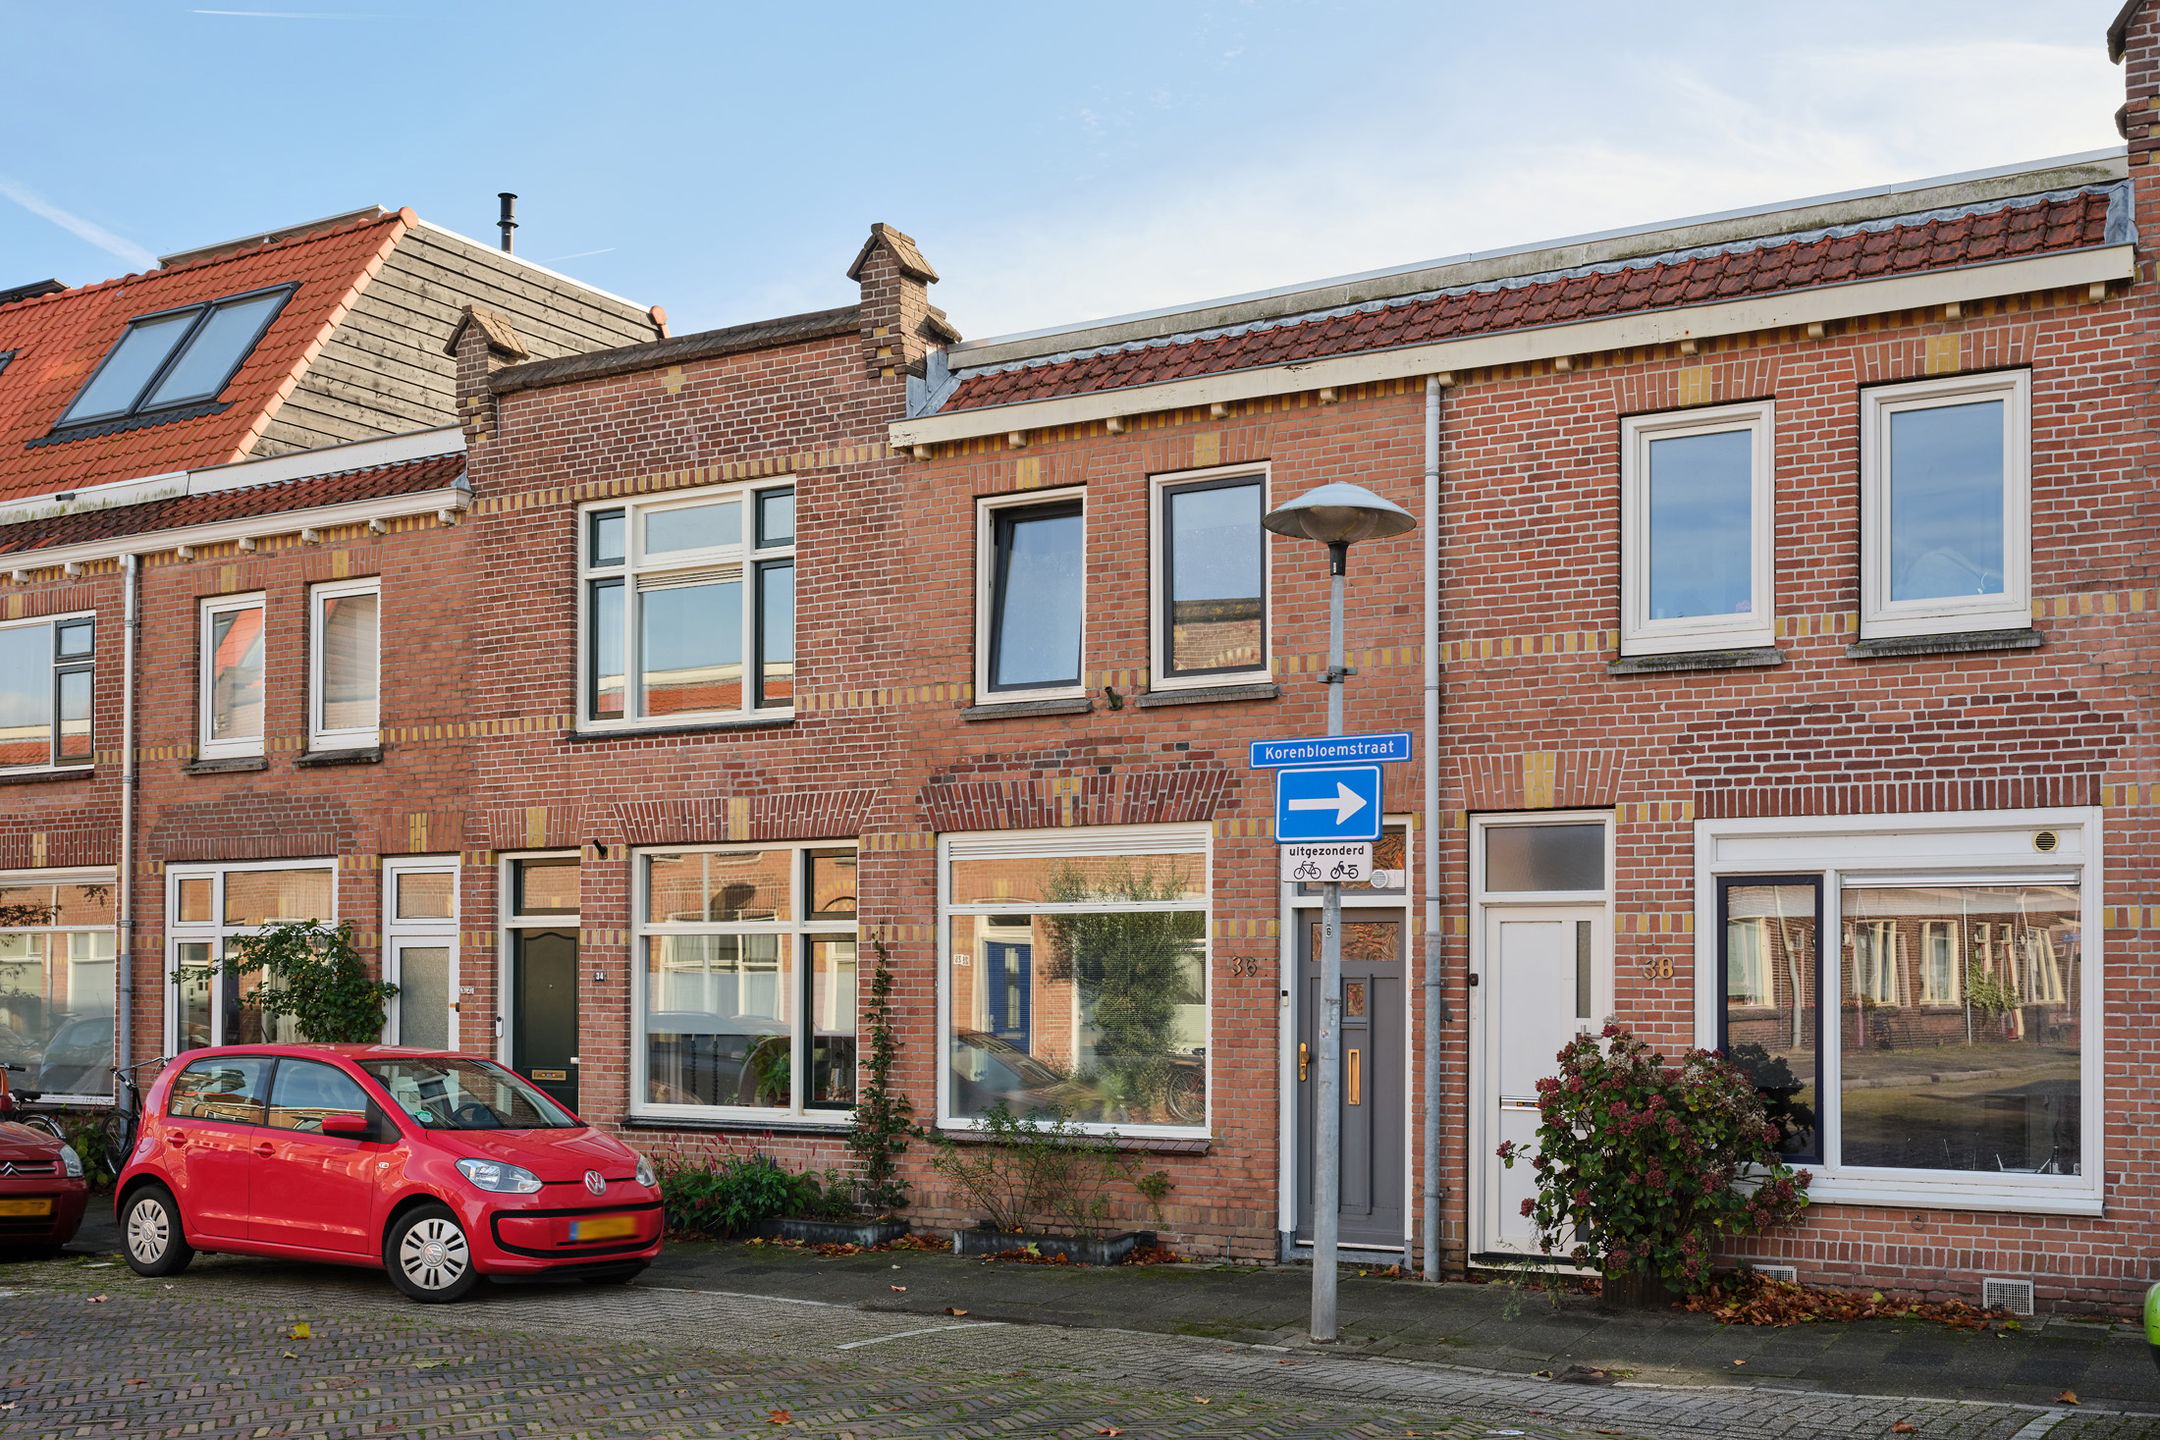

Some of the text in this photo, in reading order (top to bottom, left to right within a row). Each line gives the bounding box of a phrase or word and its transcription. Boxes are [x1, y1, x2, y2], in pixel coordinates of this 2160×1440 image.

[1265, 740, 1394, 760] Korenbloemstraat
[1289, 845, 1365, 858] uitgezonderd
[1232, 954, 1257, 977] 36
[1643, 957, 1674, 980] 38
